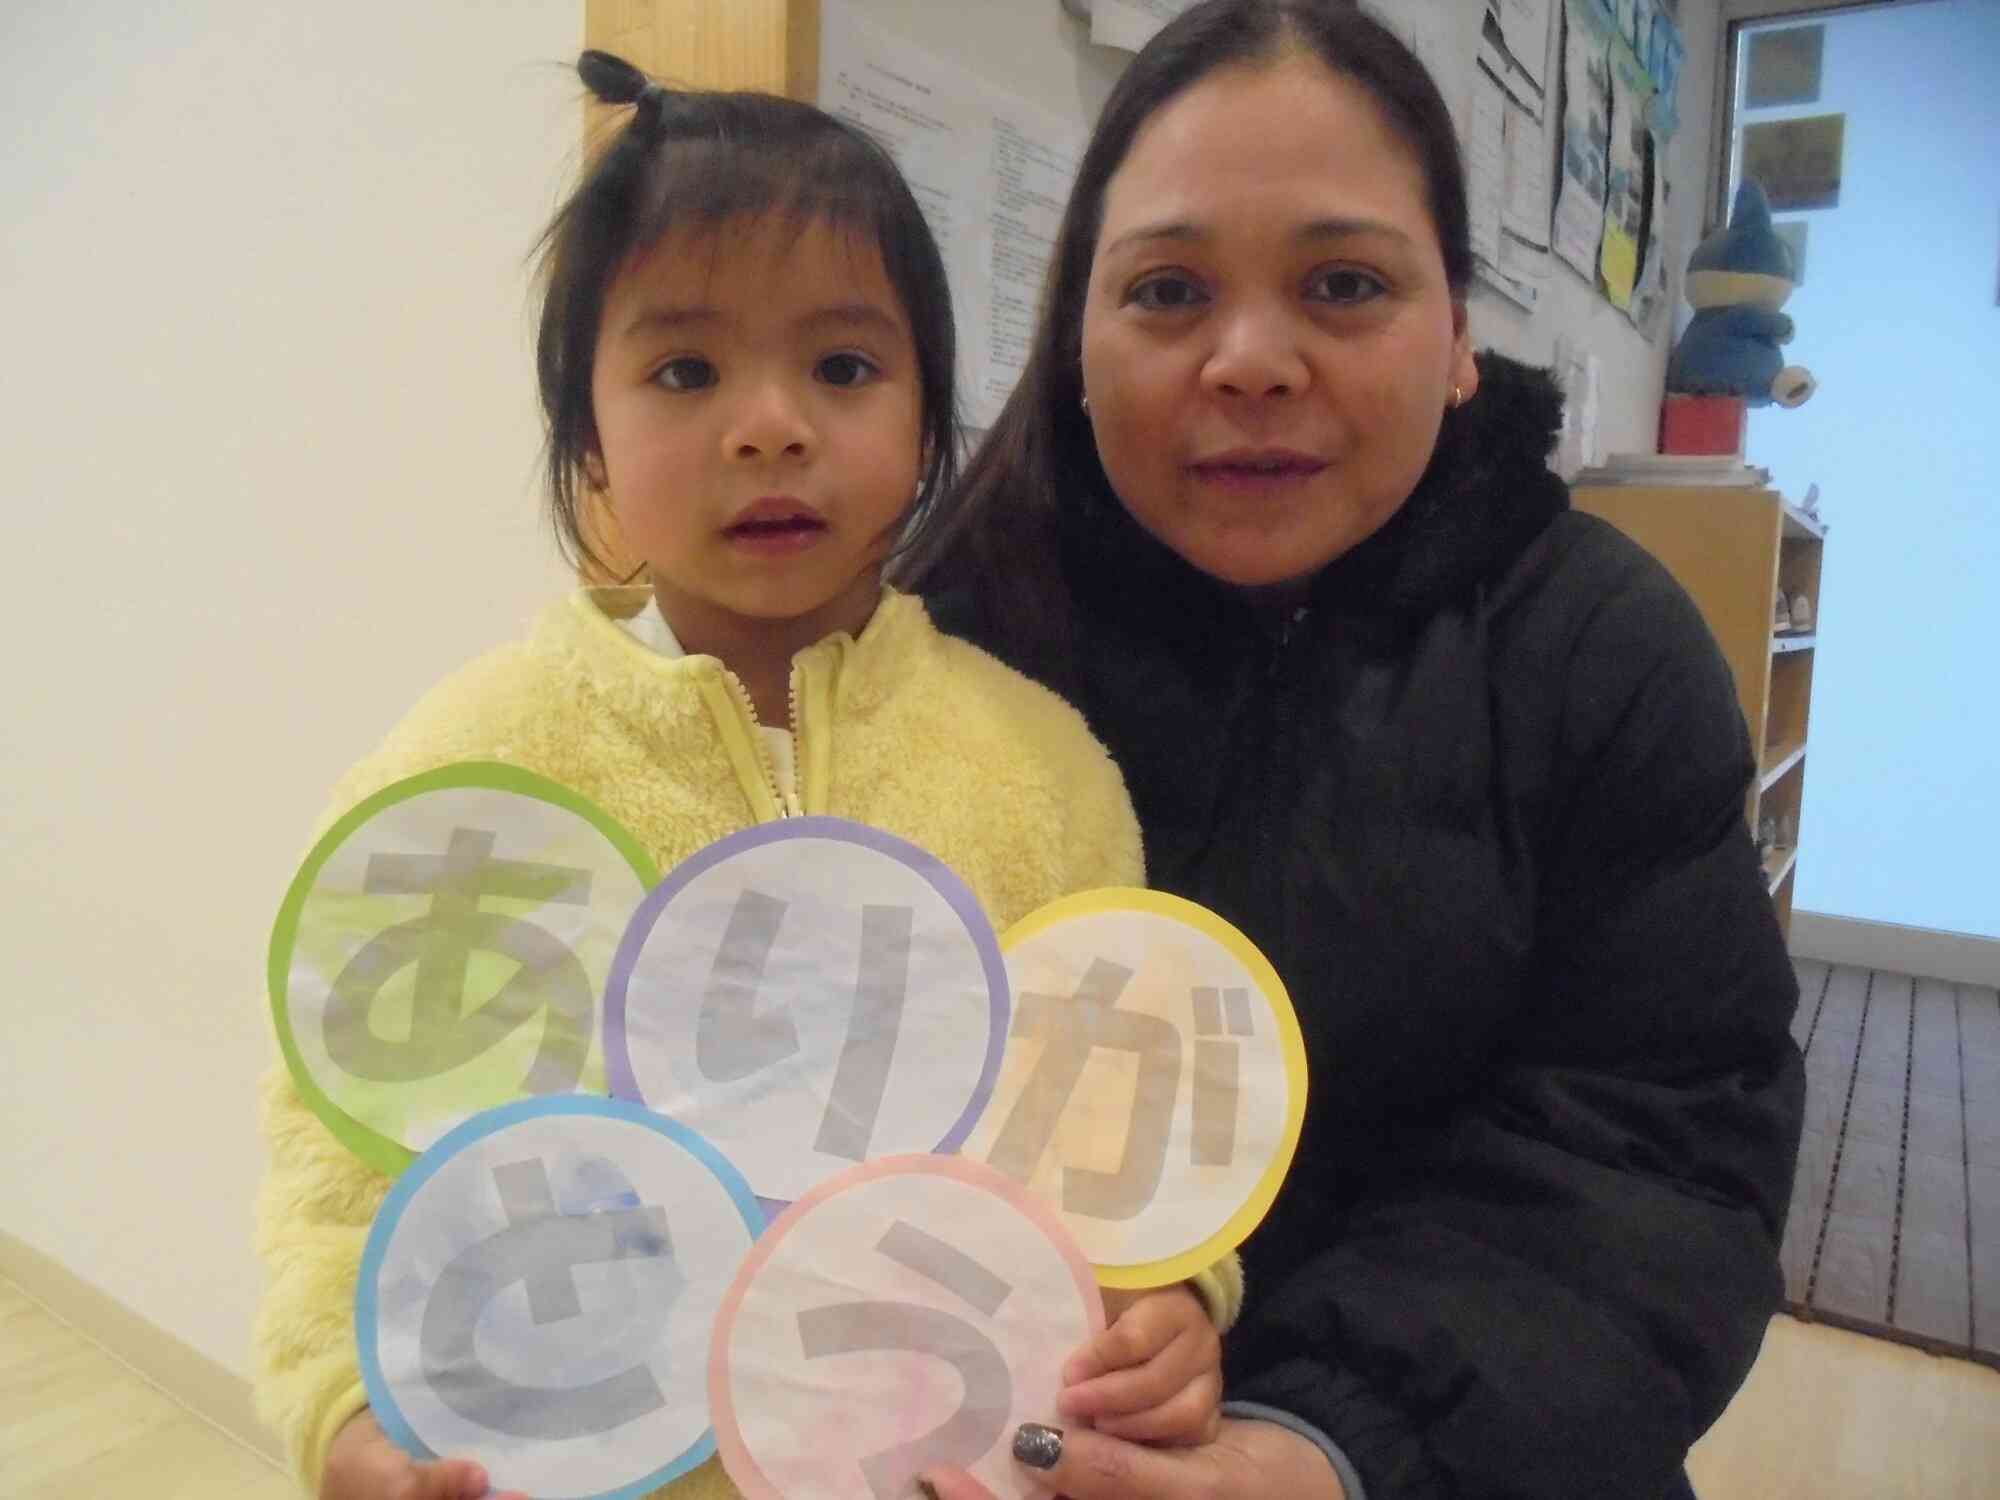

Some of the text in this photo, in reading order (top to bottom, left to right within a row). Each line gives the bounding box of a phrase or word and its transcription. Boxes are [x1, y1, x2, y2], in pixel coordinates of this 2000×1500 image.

[322, 826, 593, 1094] あ
[695, 889, 914, 1162] り
[986, 956, 1255, 1222] が
[420, 1156, 675, 1441] と
[796, 1218, 1014, 1500] う
